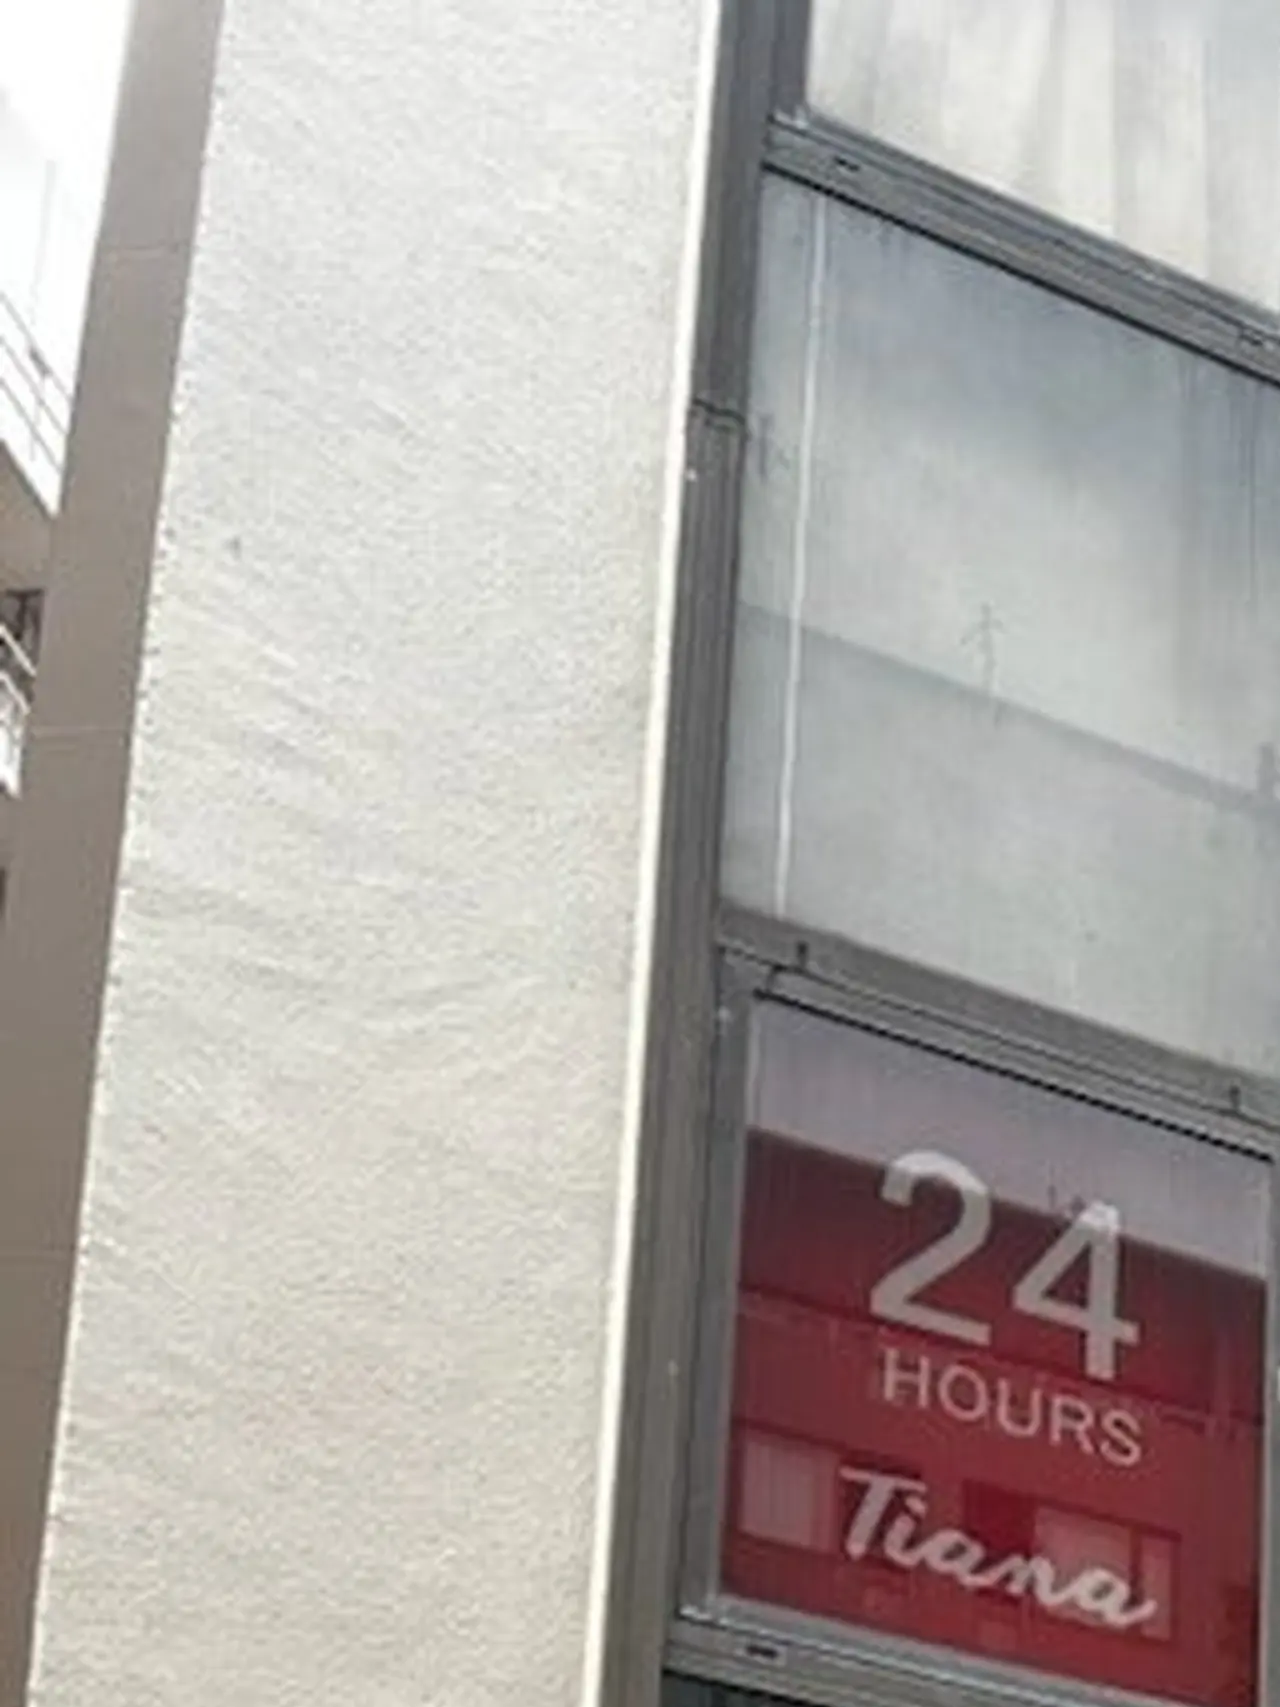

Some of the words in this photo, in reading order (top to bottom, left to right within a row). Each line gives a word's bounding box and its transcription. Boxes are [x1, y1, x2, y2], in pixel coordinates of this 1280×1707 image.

[869, 1149, 1140, 1381] 24
[878, 1346, 1143, 1468] HOURS
[840, 1466, 1158, 1630] Tiana
